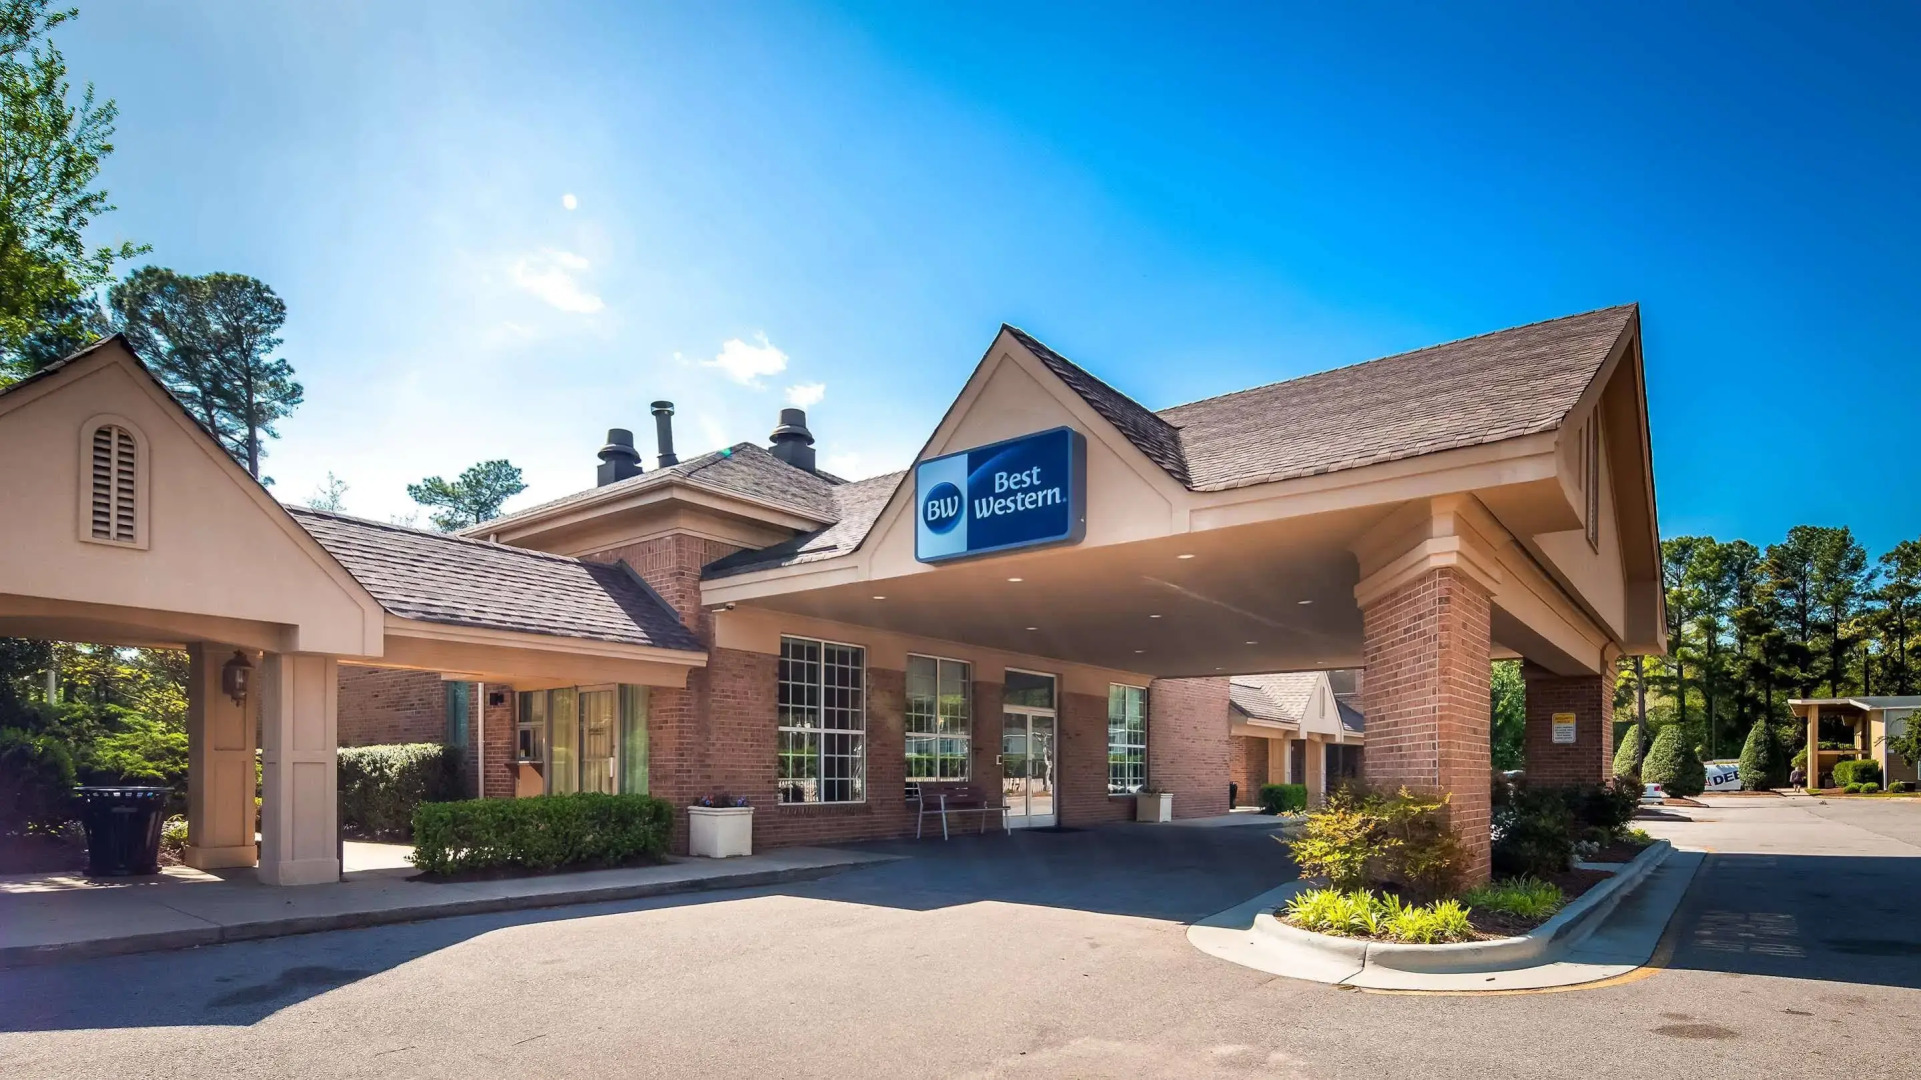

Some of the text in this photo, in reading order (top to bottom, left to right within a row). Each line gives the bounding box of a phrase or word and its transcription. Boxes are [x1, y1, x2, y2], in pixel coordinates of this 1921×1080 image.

[995, 466, 1041, 493] Best
[927, 495, 959, 521] BW
[974, 487, 1062, 519] Western
